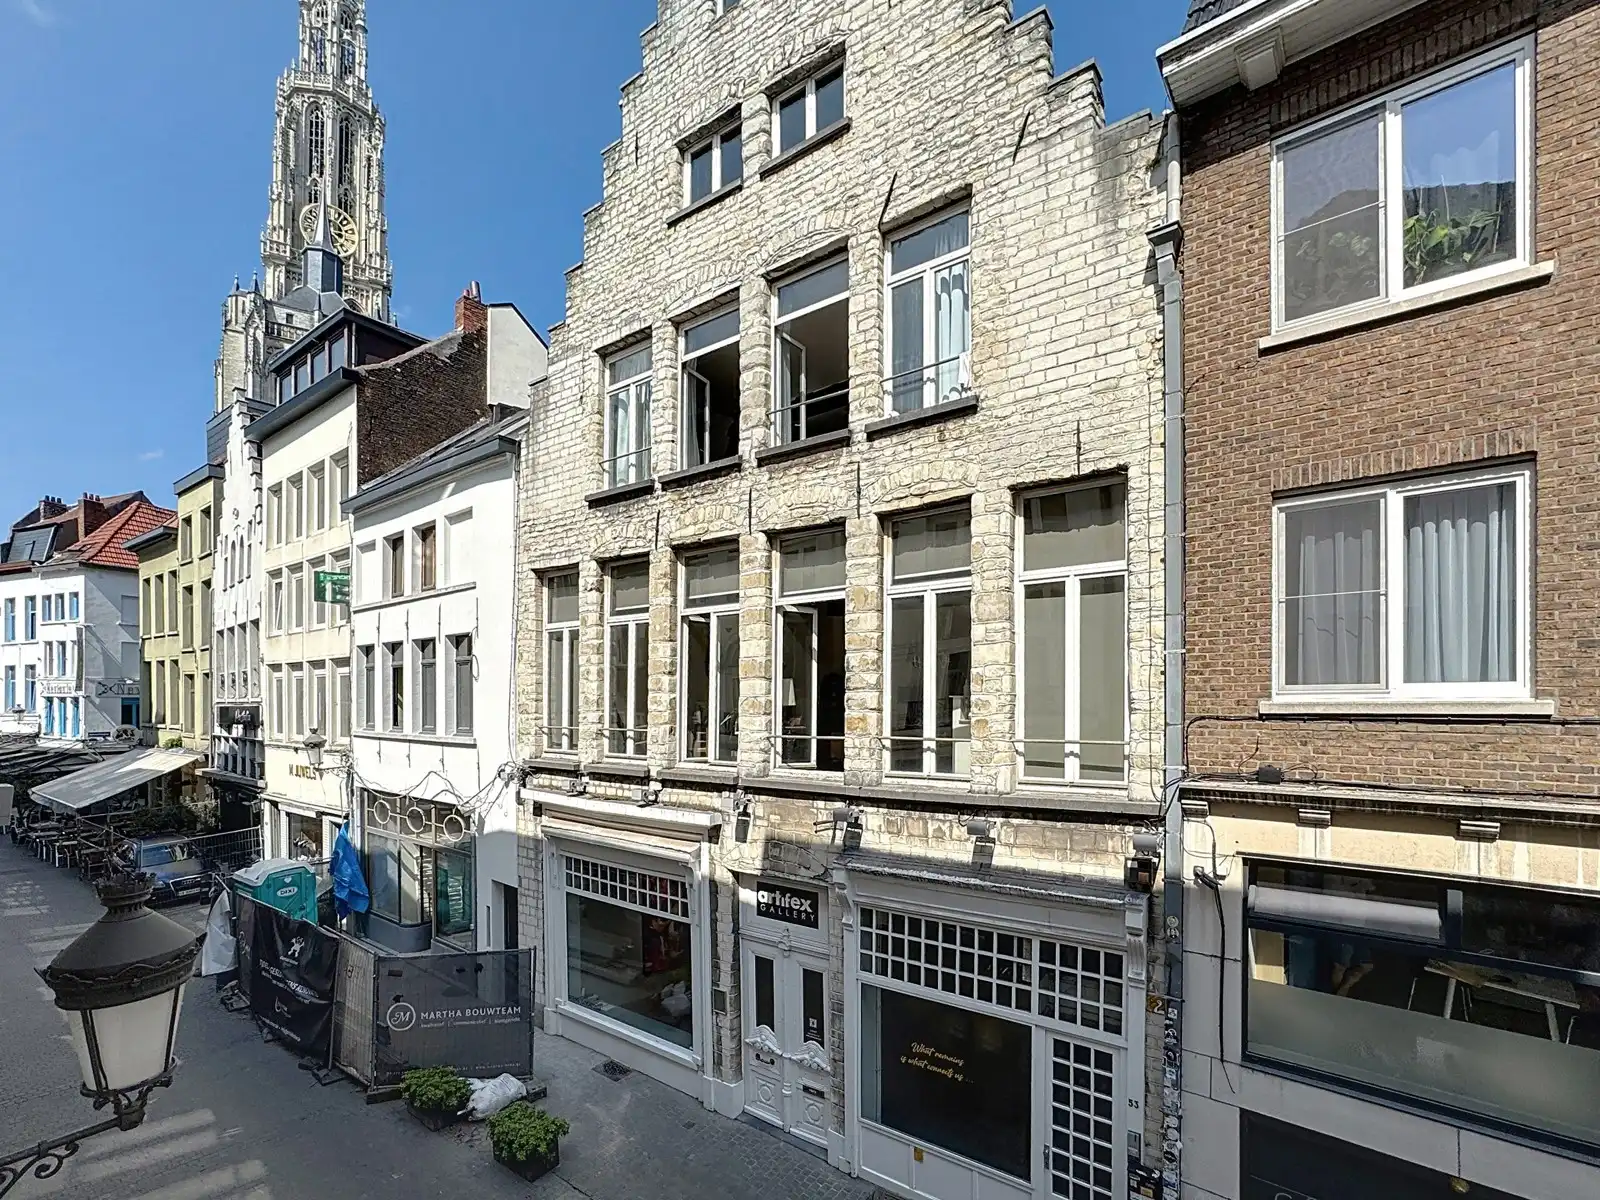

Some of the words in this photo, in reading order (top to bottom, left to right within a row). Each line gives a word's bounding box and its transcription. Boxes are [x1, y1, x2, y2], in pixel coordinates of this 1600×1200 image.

[757, 890, 813, 912] artifex
[760, 904, 815, 921] GALLERY
[420, 1010, 462, 1020] MARTHA
[465, 1006, 521, 1017] BOUWTEAM
[911, 1042, 935, 1056] What
[907, 1057, 928, 1068] what
[926, 1065, 954, 1078] connects
[954, 1073, 964, 1081] us
[1128, 1098, 1139, 1109] 53
